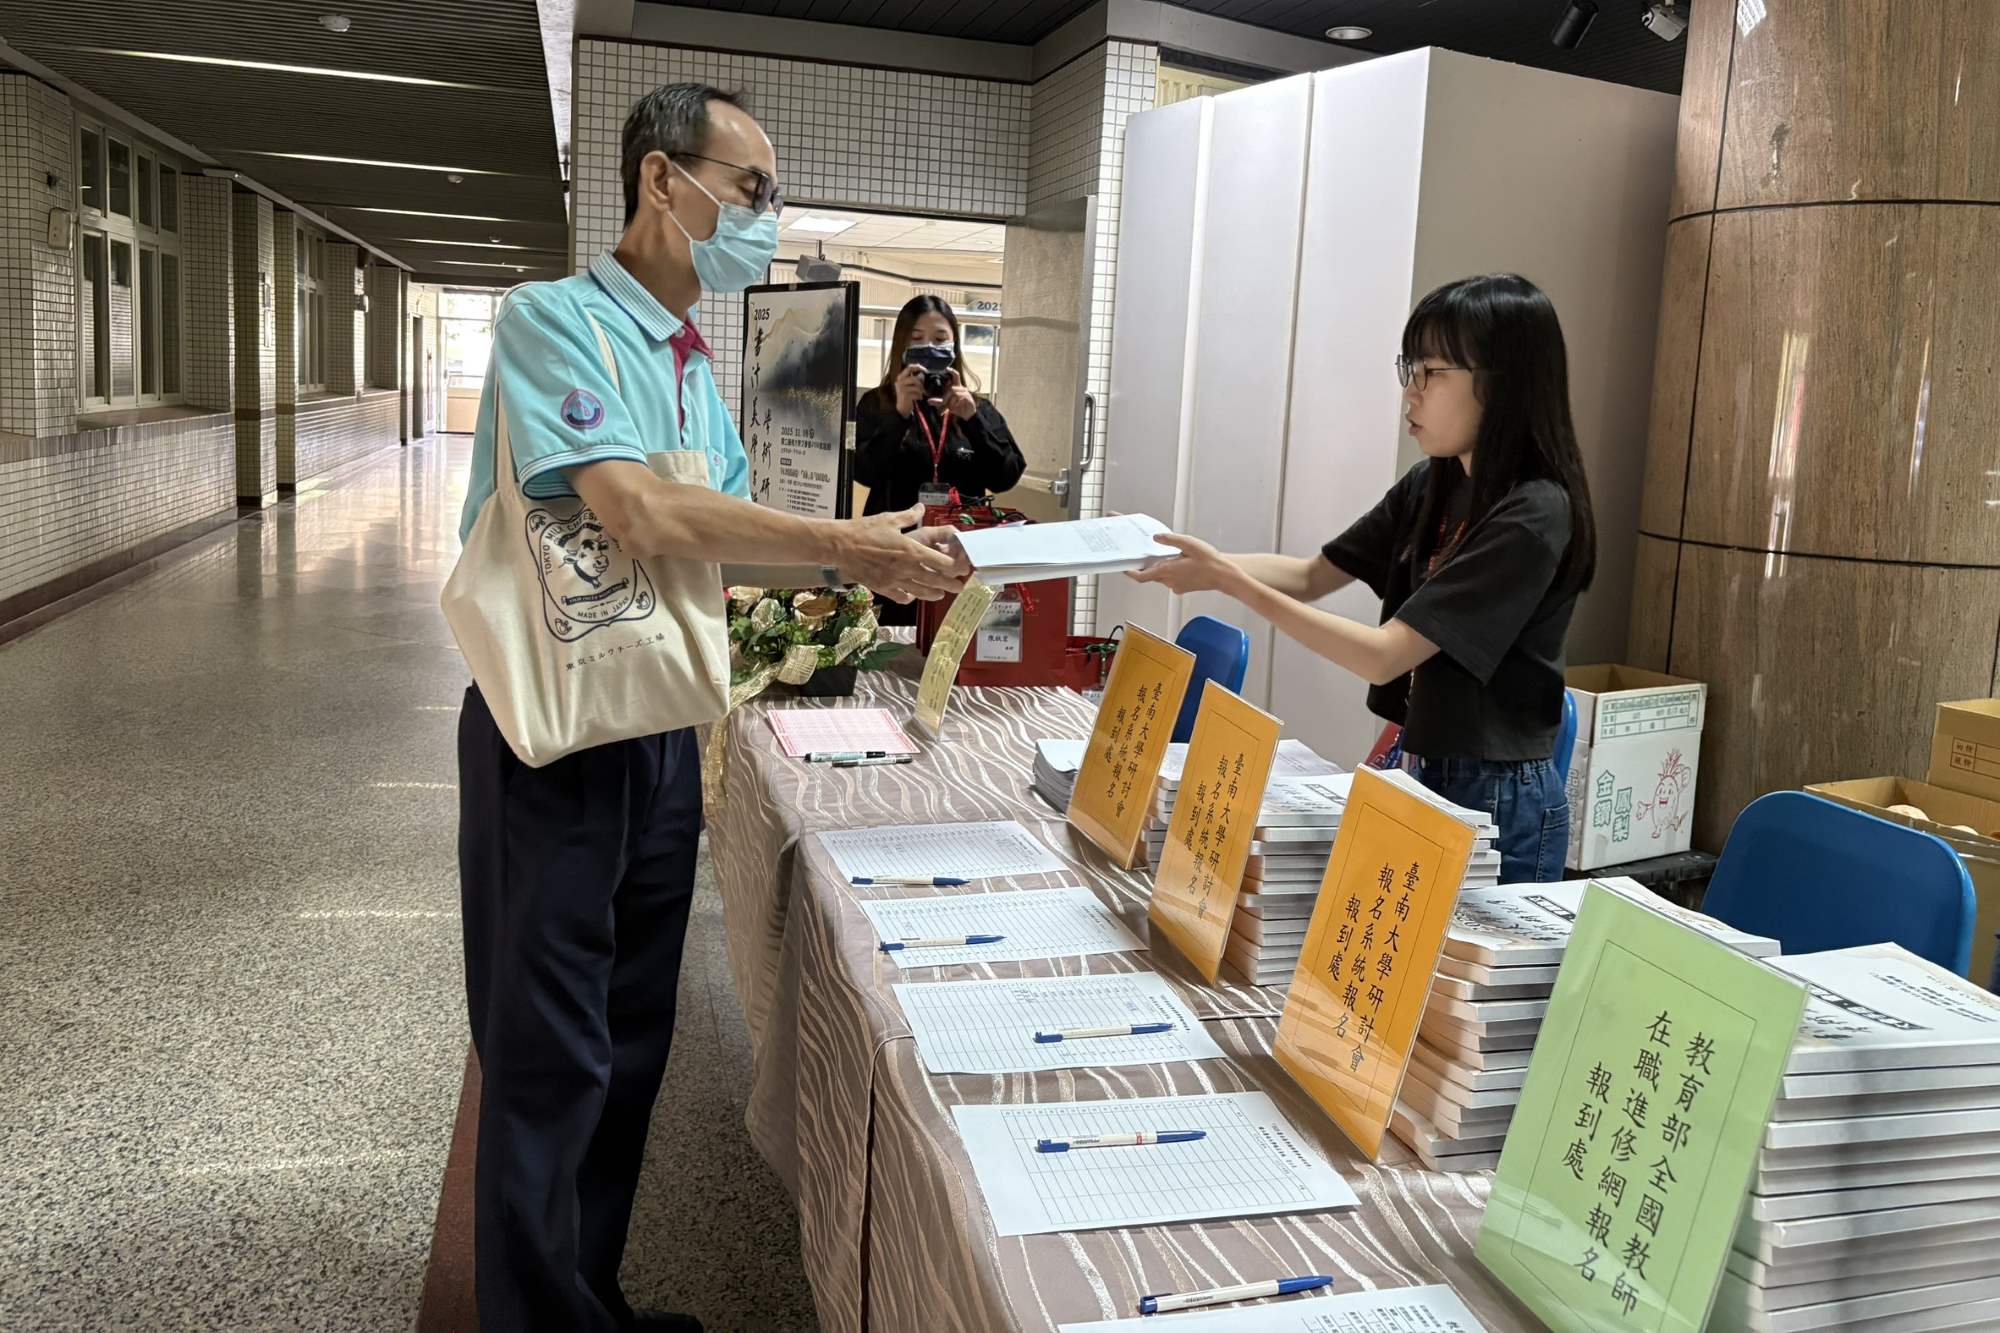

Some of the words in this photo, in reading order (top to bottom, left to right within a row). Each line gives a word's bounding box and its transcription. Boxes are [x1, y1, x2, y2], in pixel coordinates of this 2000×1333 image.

[753, 307, 770, 321] 2025
[544, 544, 553, 576] TOKYO
[577, 610, 597, 620] MADE
[600, 609, 609, 617] IN
[612, 595, 630, 613] JAPAN
[1103, 707, 1128, 764] 報到處
[1105, 684, 1147, 799] 報名系統報名
[1113, 682, 1164, 819] 臺南大學研討會
[1183, 780, 1207, 852] 報到處
[1186, 754, 1229, 896] 報名系統報名
[1197, 753, 1245, 920] 臺南大學研討會
[1325, 893, 1361, 984] 報到處
[1331, 863, 1396, 1039] 報名系統報名
[1347, 861, 1421, 1074] 臺南大學研討會
[1560, 1059, 1614, 1184] 報到處
[1572, 1008, 1672, 1284] 在職進修網報名
[1609, 1030, 1718, 1318] 教育部全國教師
